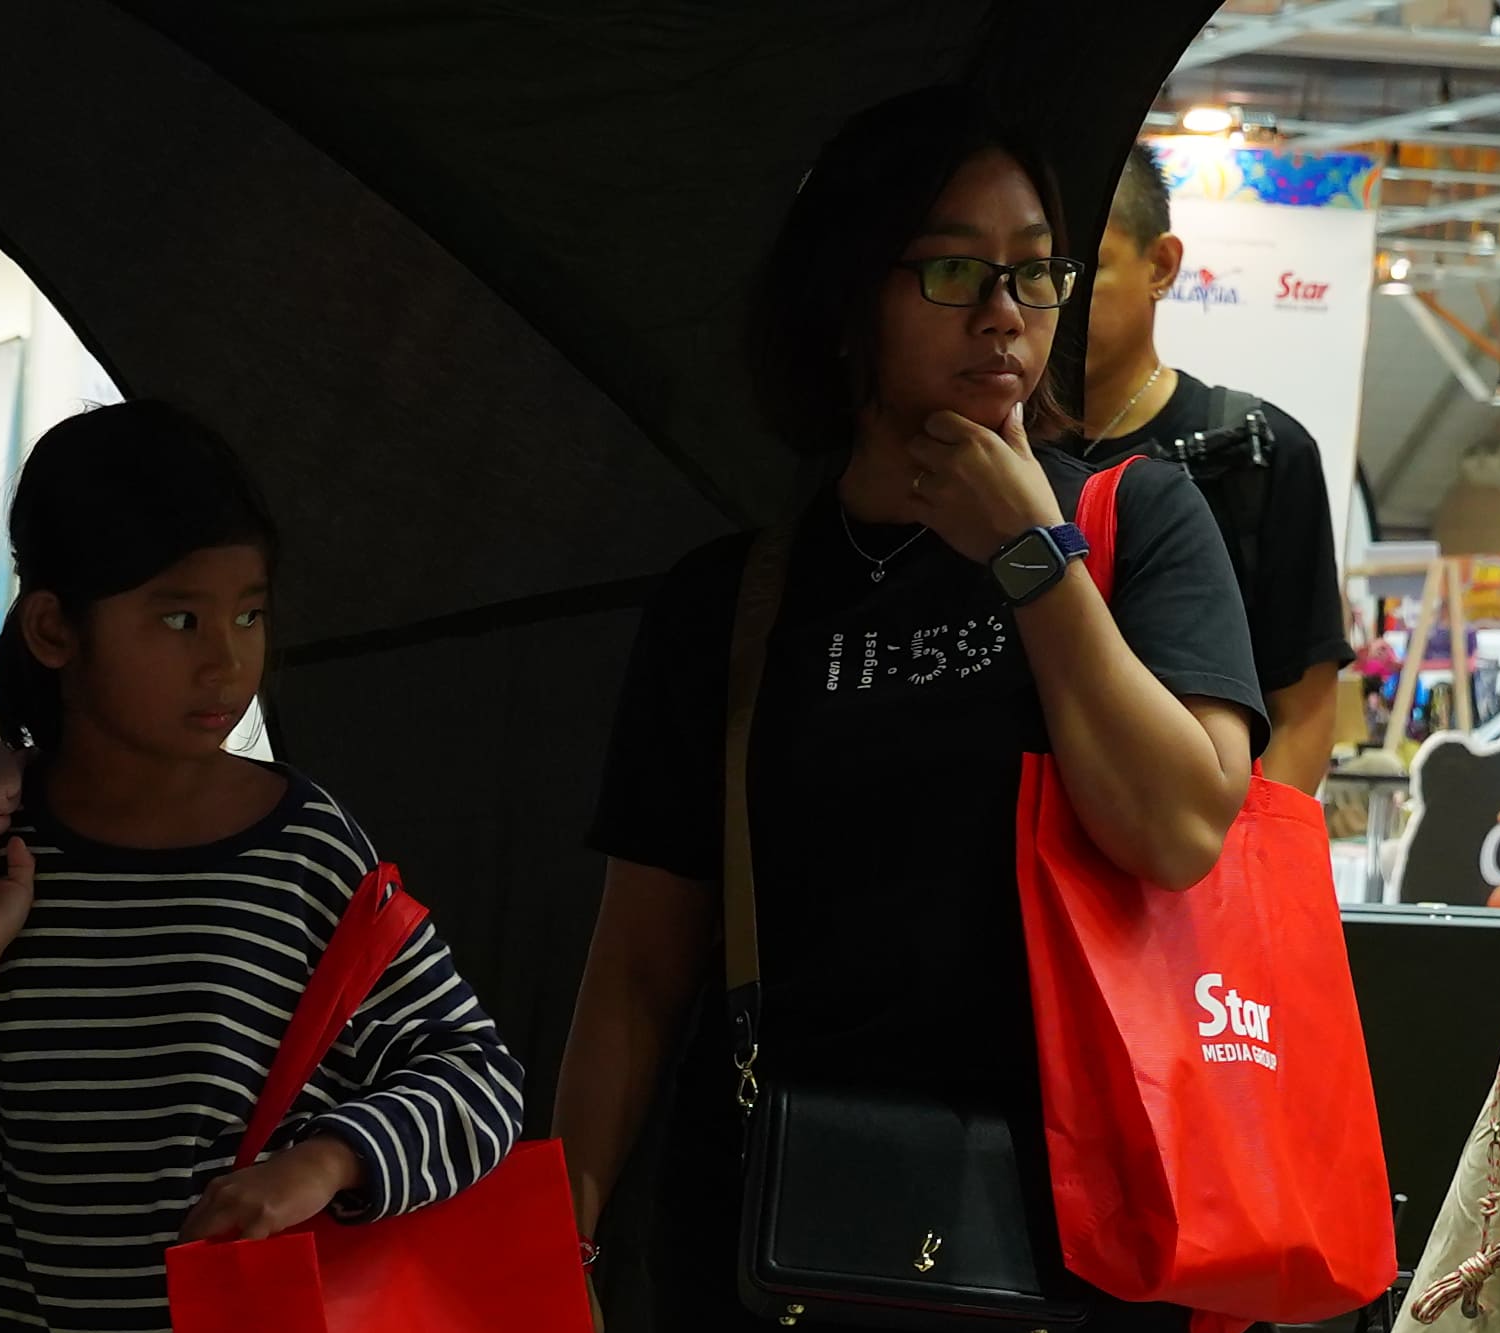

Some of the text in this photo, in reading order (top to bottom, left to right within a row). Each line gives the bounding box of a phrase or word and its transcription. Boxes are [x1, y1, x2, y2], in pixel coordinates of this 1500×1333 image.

[1275, 270, 1330, 300] Star
[913, 624, 949, 639] days
[826, 633, 844, 691] even the
[857, 631, 878, 690] longest
[907, 647, 947, 685] eventually
[910, 638, 925, 660] will
[1194, 972, 1271, 1043] Star
[1201, 1043, 1253, 1062] MEDIA
